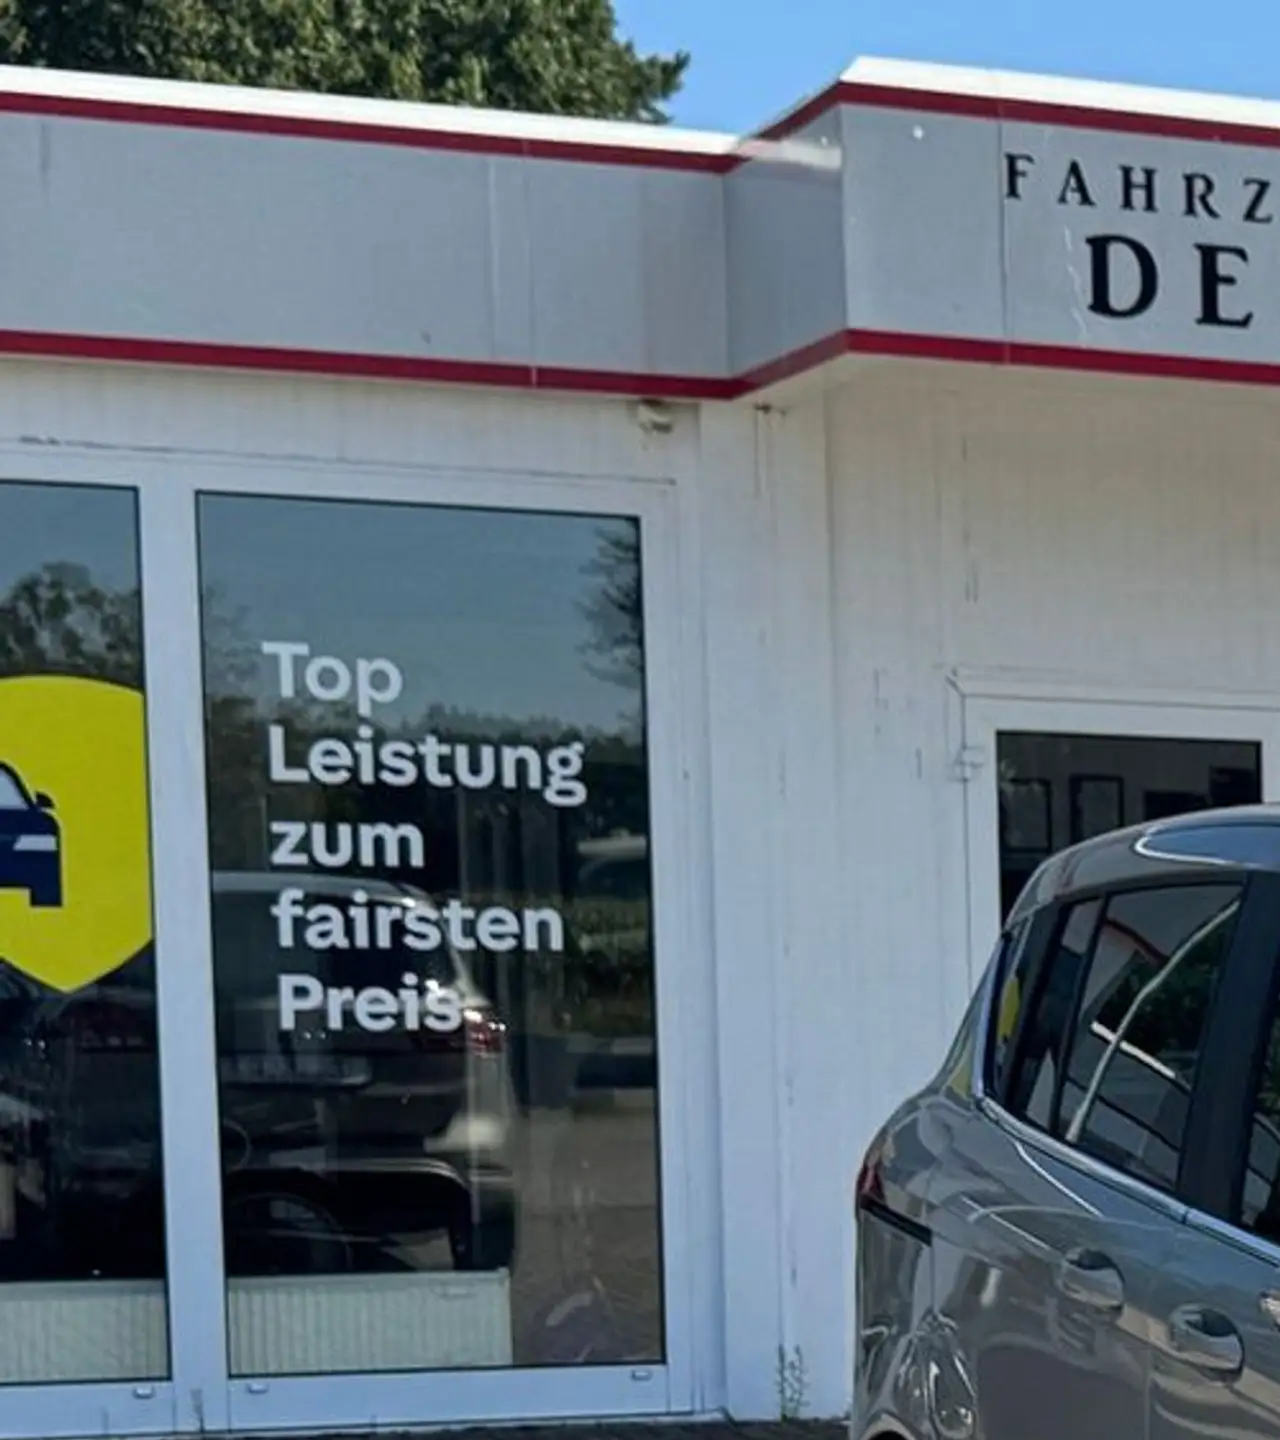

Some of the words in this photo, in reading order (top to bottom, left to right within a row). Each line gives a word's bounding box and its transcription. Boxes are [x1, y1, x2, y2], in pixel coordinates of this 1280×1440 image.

[262, 641, 403, 716] Top
[268, 724, 588, 807] Leistung
[270, 820, 425, 868] zum
[271, 890, 565, 952] fairsten
[278, 973, 464, 1033] Preis
